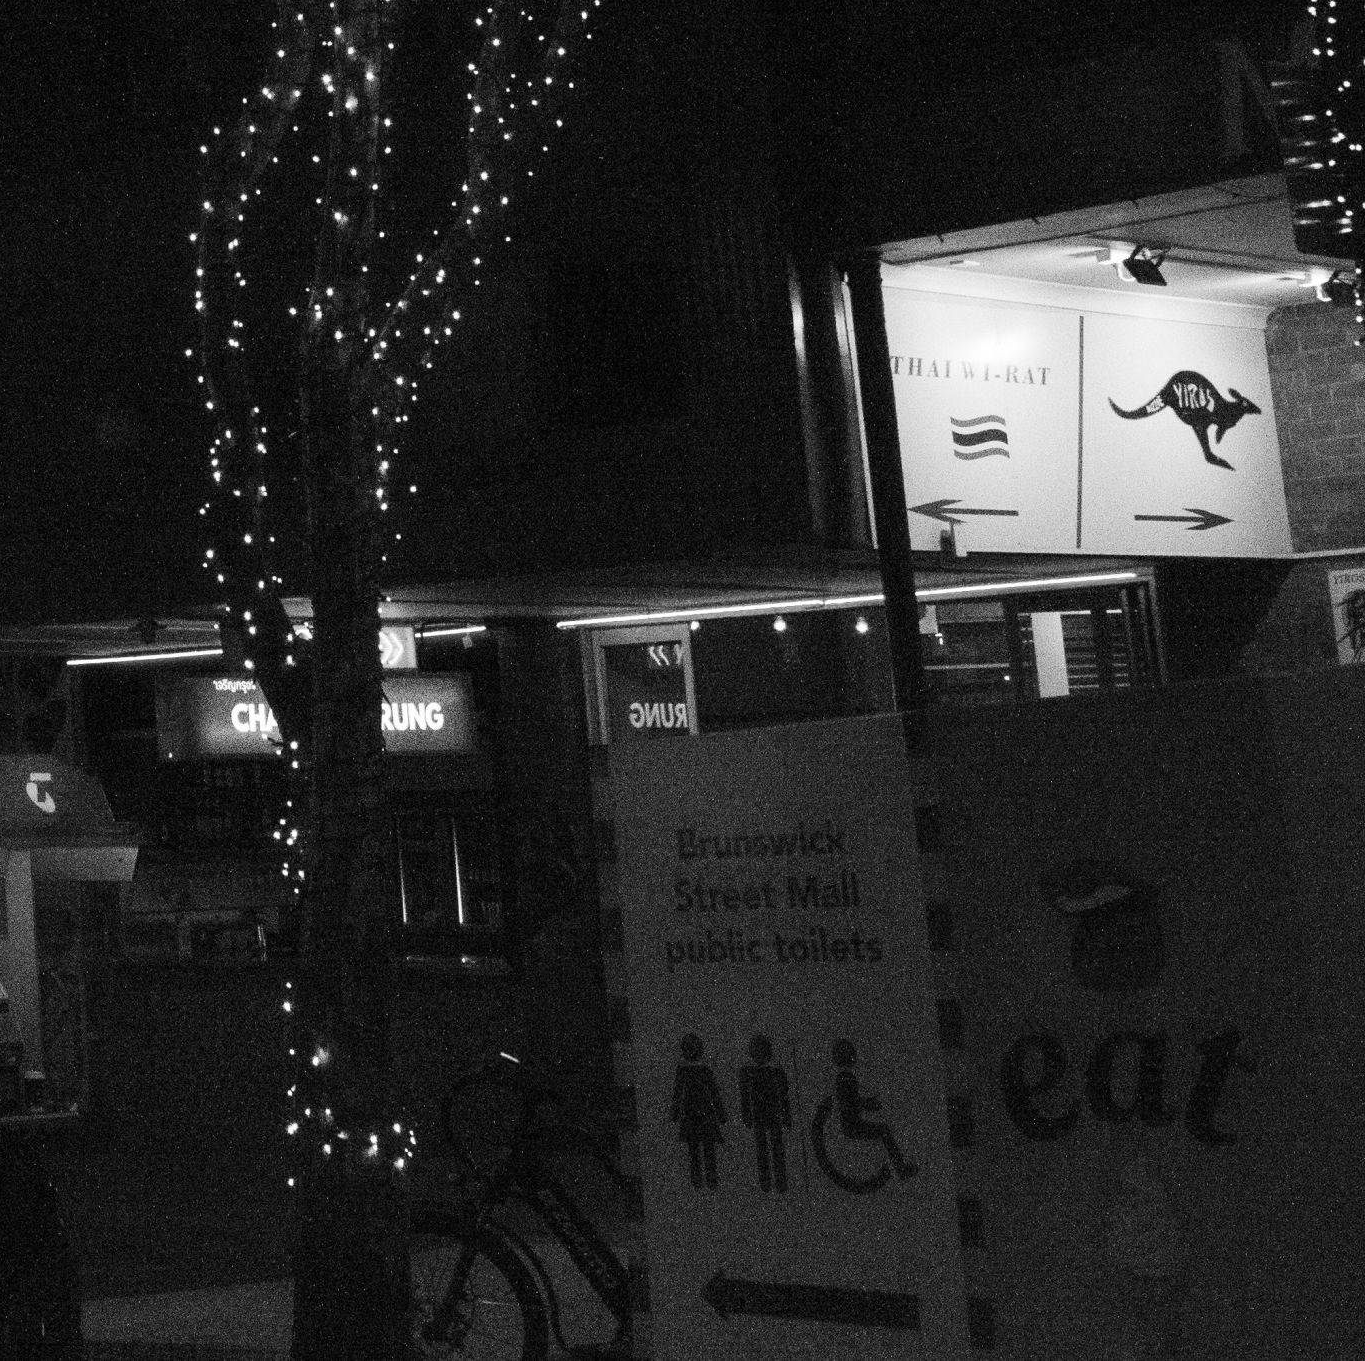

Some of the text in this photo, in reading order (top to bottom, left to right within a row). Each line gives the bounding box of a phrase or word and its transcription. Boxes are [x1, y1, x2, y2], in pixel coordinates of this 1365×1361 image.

[890, 355, 1051, 386] THAI WI-RAT
[1172, 382, 1215, 413] YIROS
[380, 703, 444, 731] RUNG
[676, 819, 845, 860] Brunswick
[675, 870, 860, 912] Street Mall
[665, 926, 883, 973] public toilets
[1000, 1028, 1258, 1146] eat
